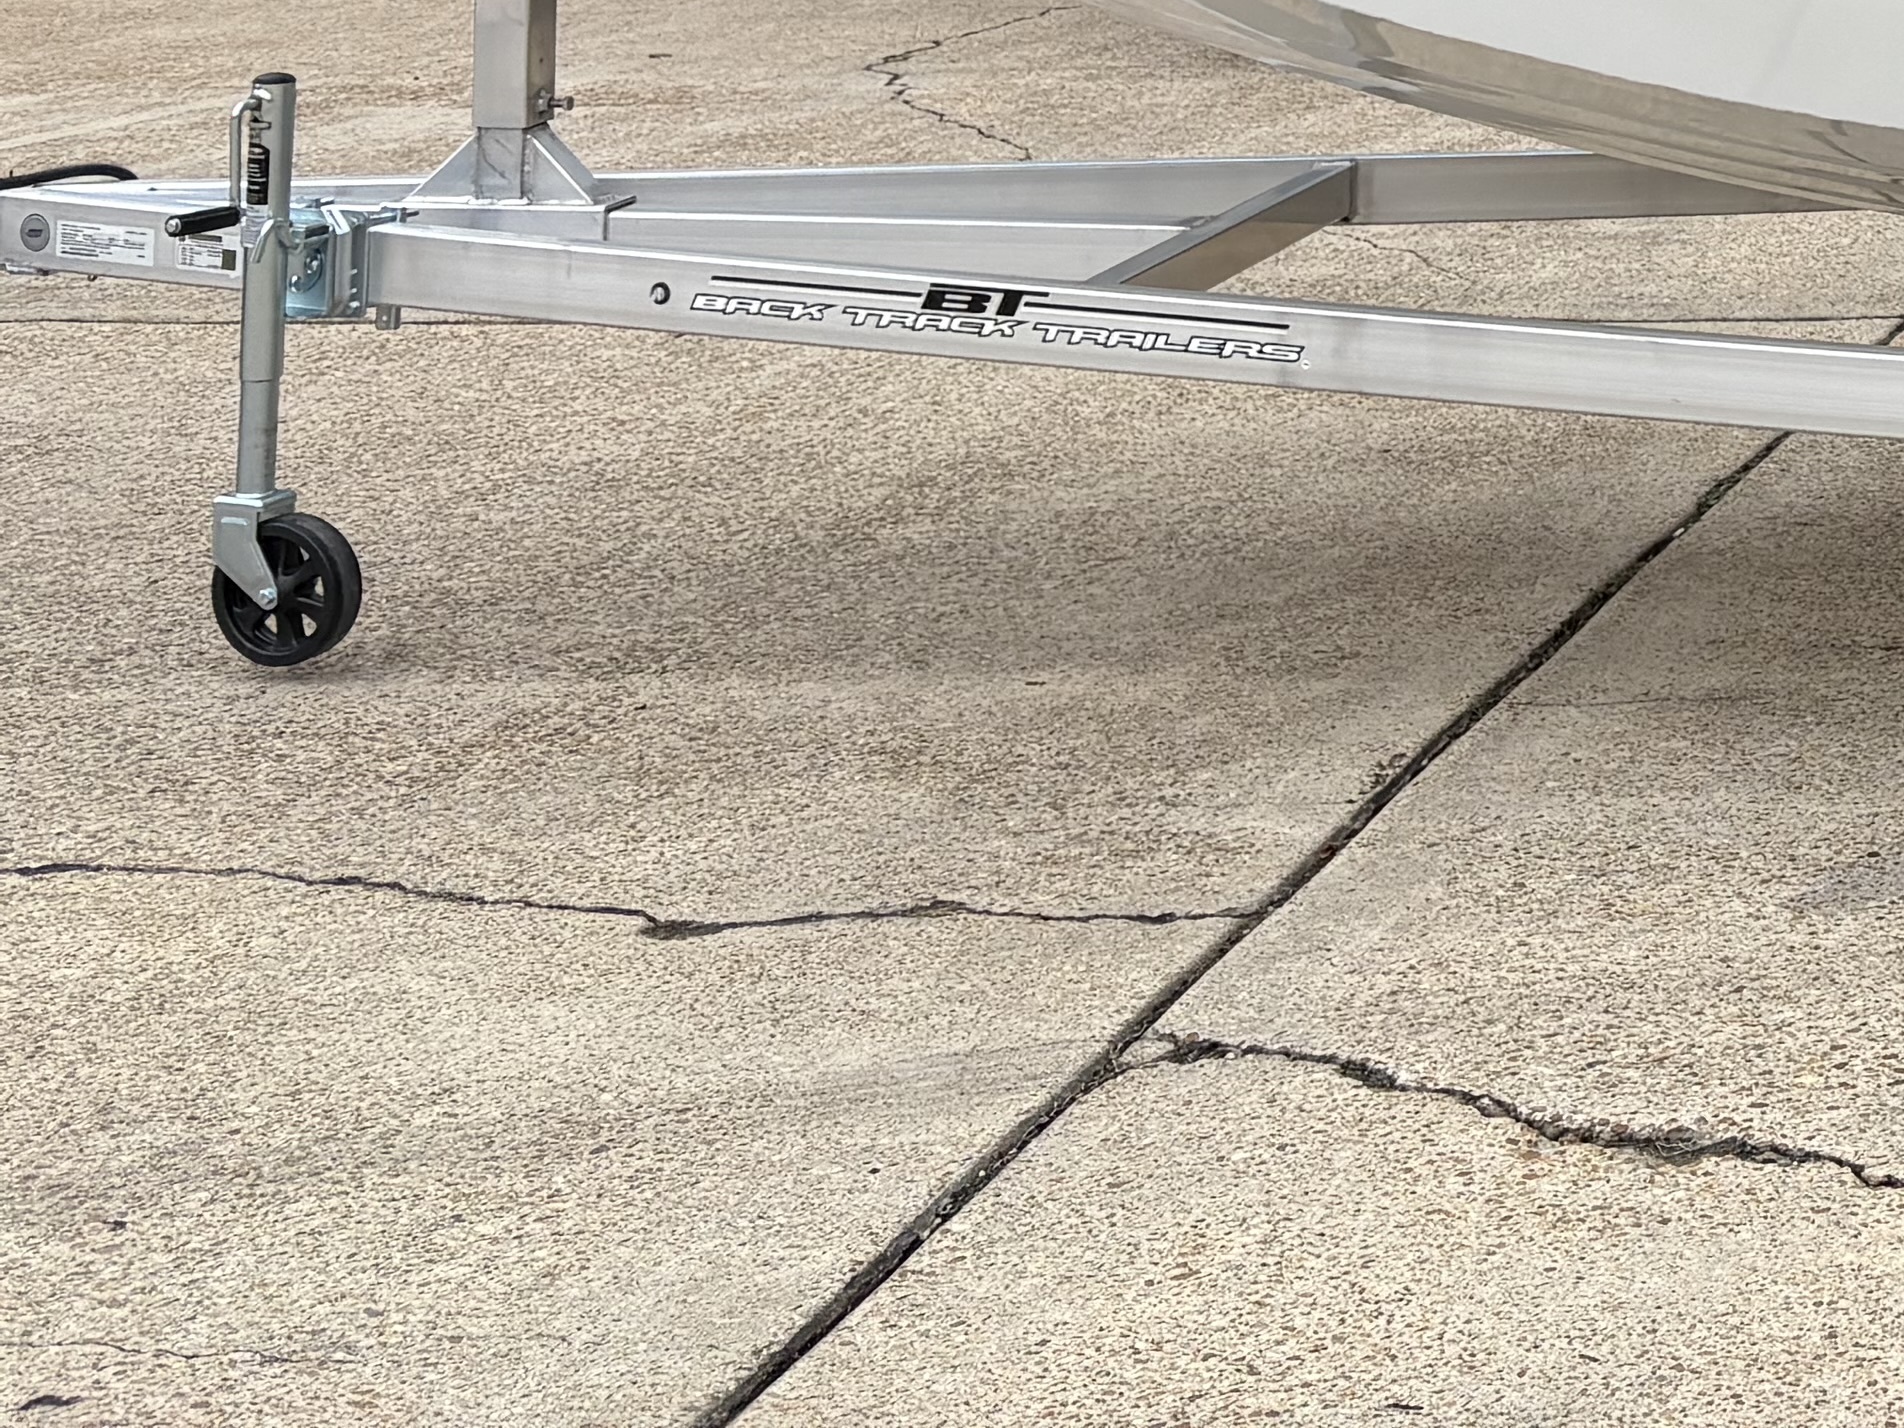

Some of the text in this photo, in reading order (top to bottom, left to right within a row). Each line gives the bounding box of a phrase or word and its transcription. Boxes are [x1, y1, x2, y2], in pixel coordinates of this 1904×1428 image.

[920, 282, 1050, 317] BT
[689, 292, 1306, 364] BACK TRACK TRAILERS
